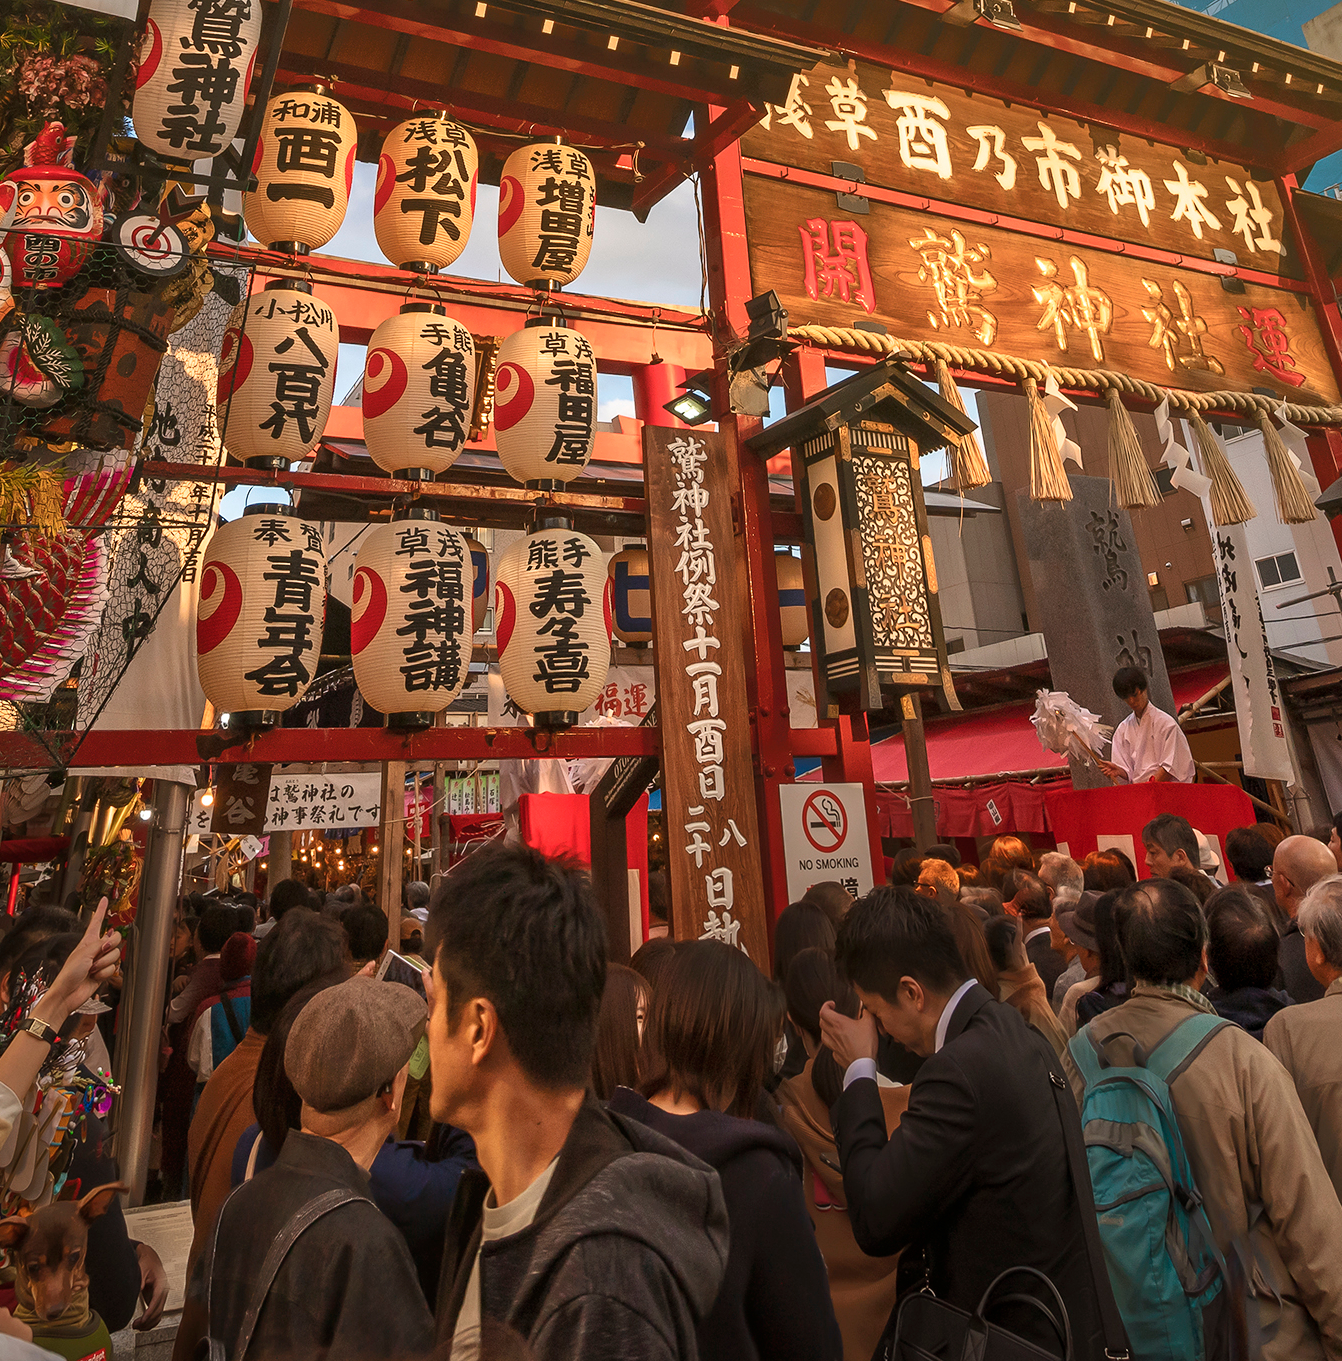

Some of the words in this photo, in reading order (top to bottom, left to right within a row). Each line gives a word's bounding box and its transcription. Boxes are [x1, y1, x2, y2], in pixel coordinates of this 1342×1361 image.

[404, 120, 471, 150] 浅草
[531, 149, 591, 181] 浅草
[396, 148, 469, 246] 松下
[533, 178, 587, 272] 増田屋
[797, 216, 877, 314] 開
[907, 226, 1225, 377] 鷲神社
[254, 298, 334, 332] 小松川
[1235, 304, 1306, 388] 運
[259, 326, 333, 444] 八百代
[414, 349, 470, 453] 亀谷
[545, 357, 594, 467] 福田屋
[527, 538, 591, 572] 熊手
[244, 551, 321, 698] 青年会
[394, 559, 465, 692] 福神講
[529, 571, 592, 694] 寿々喜
[666, 436, 726, 801] 鷲神社例祭十一月酉日
[799, 859, 816, 870] NO
[818, 857, 859, 869] SMOKING
